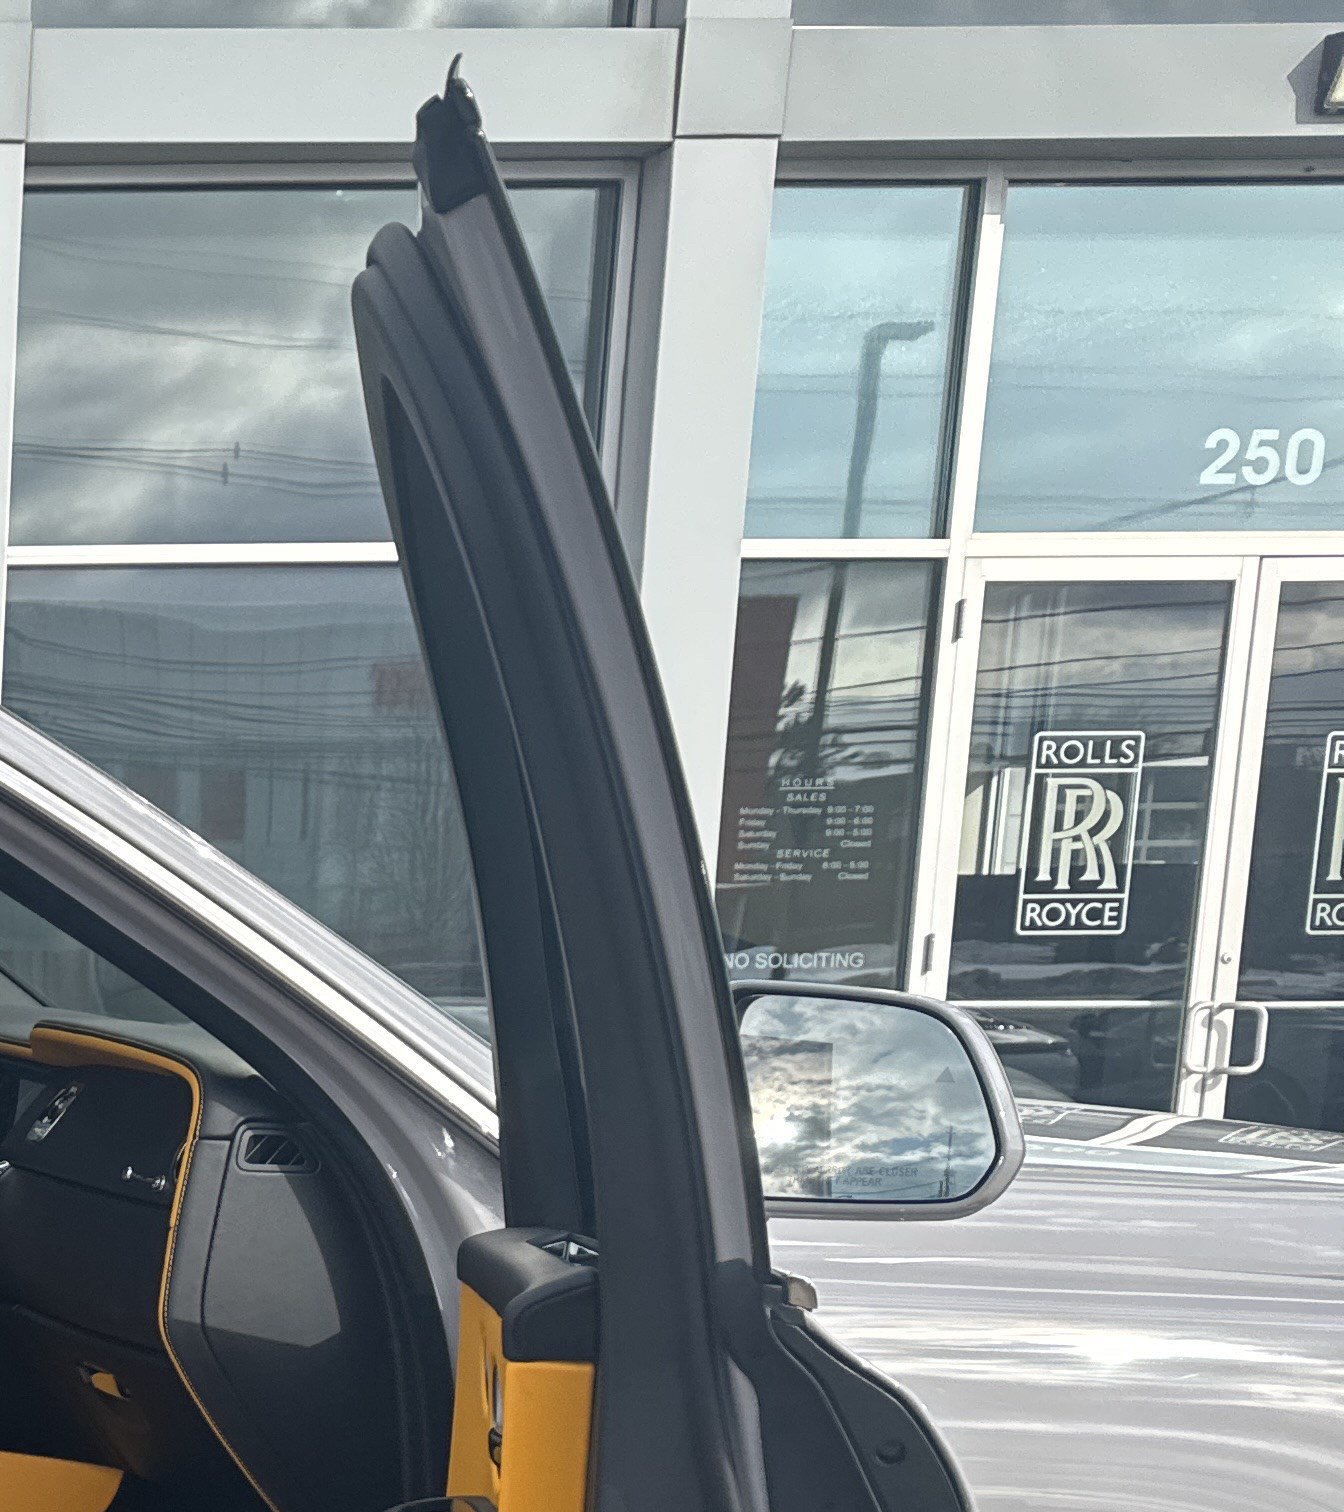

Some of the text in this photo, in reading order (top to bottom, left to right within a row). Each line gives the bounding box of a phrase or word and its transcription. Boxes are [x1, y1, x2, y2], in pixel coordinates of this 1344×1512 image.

[1199, 427, 1326, 486] 250
[1040, 739, 1136, 765] ROLLS
[781, 777, 835, 787] HOURS
[786, 792, 827, 801] SALES
[1034, 777, 1124, 890] RR
[776, 848, 830, 859] SERVICE
[1025, 902, 1120, 927] ROYCE
[724, 951, 865, 969] NO SOLICITING
